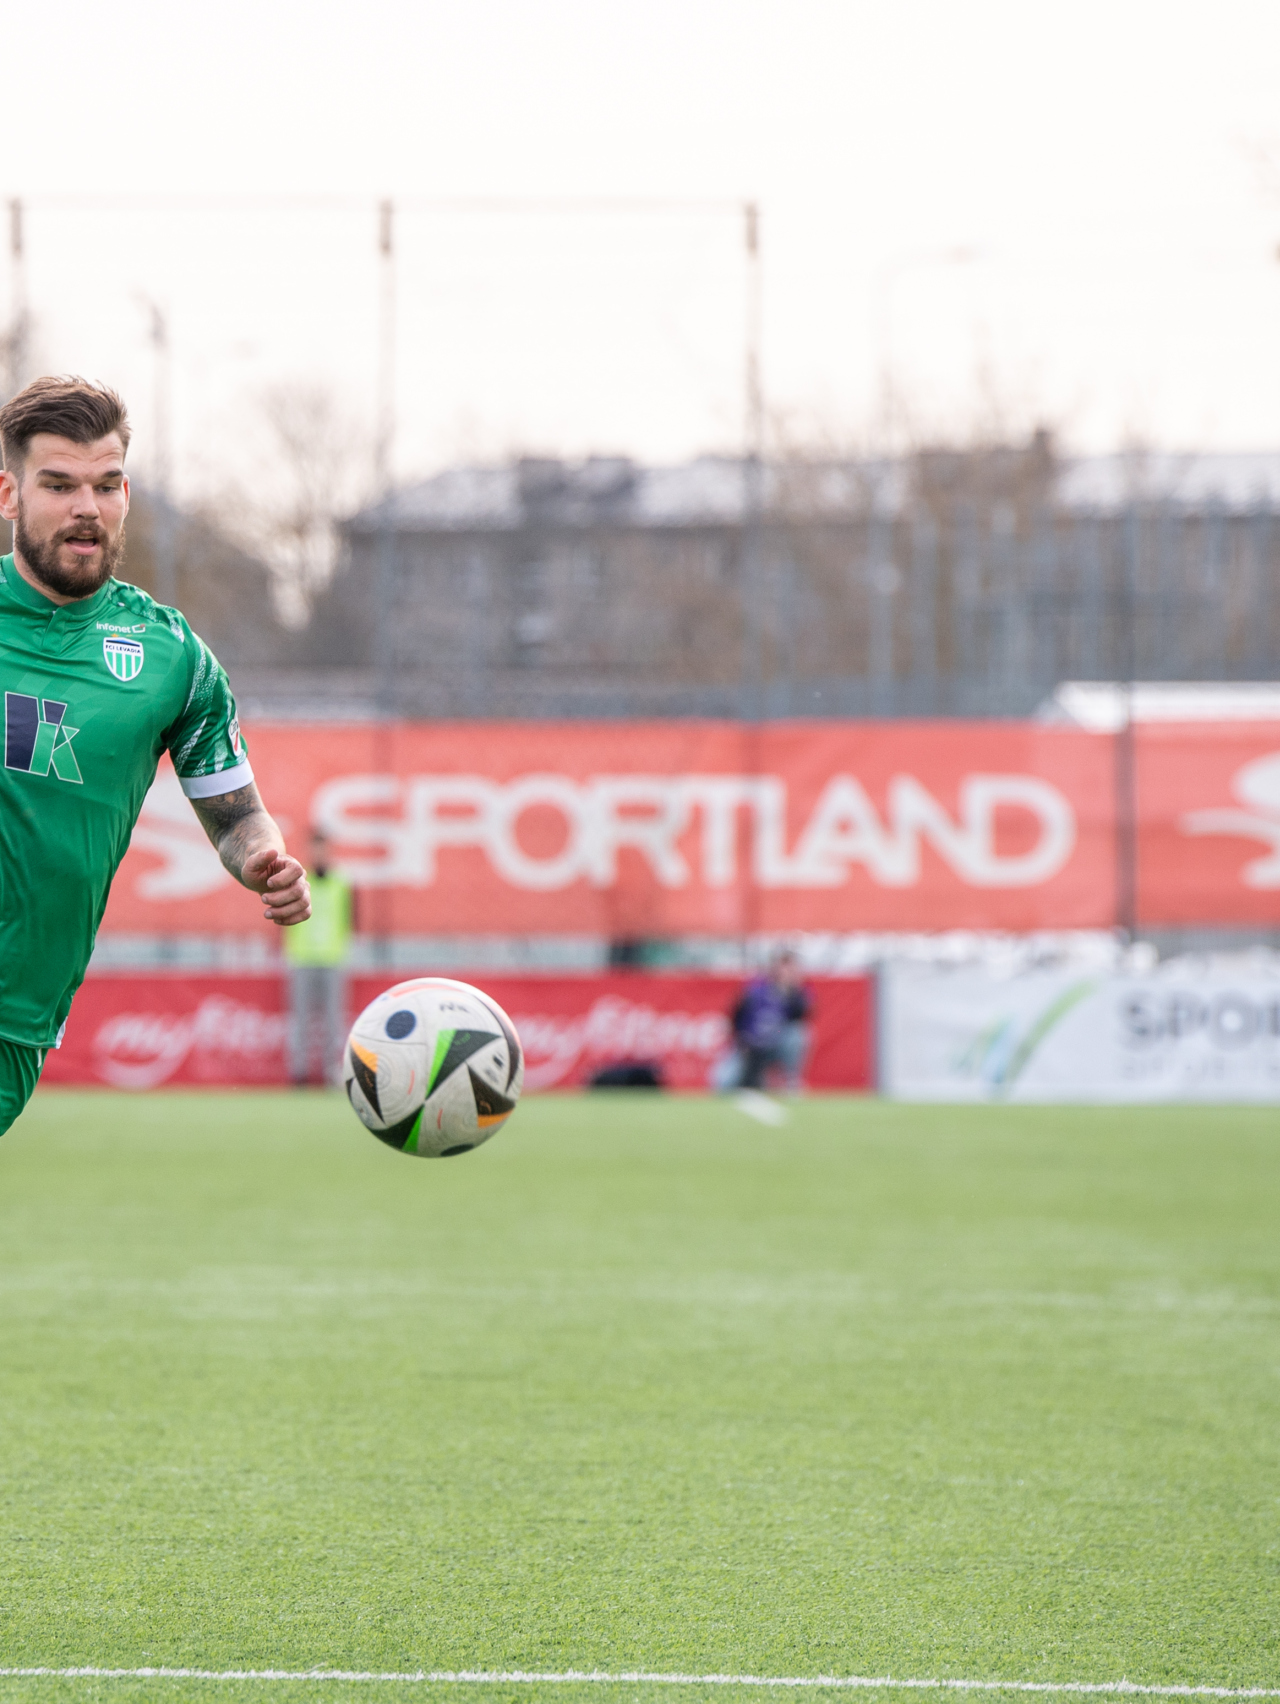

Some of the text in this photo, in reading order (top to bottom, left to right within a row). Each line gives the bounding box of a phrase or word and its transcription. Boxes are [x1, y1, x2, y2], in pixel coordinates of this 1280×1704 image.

[96, 621, 132, 634] infonet
[116, 646, 142, 654] LEVADIA
[310, 771, 1077, 891] SPORTLAND
